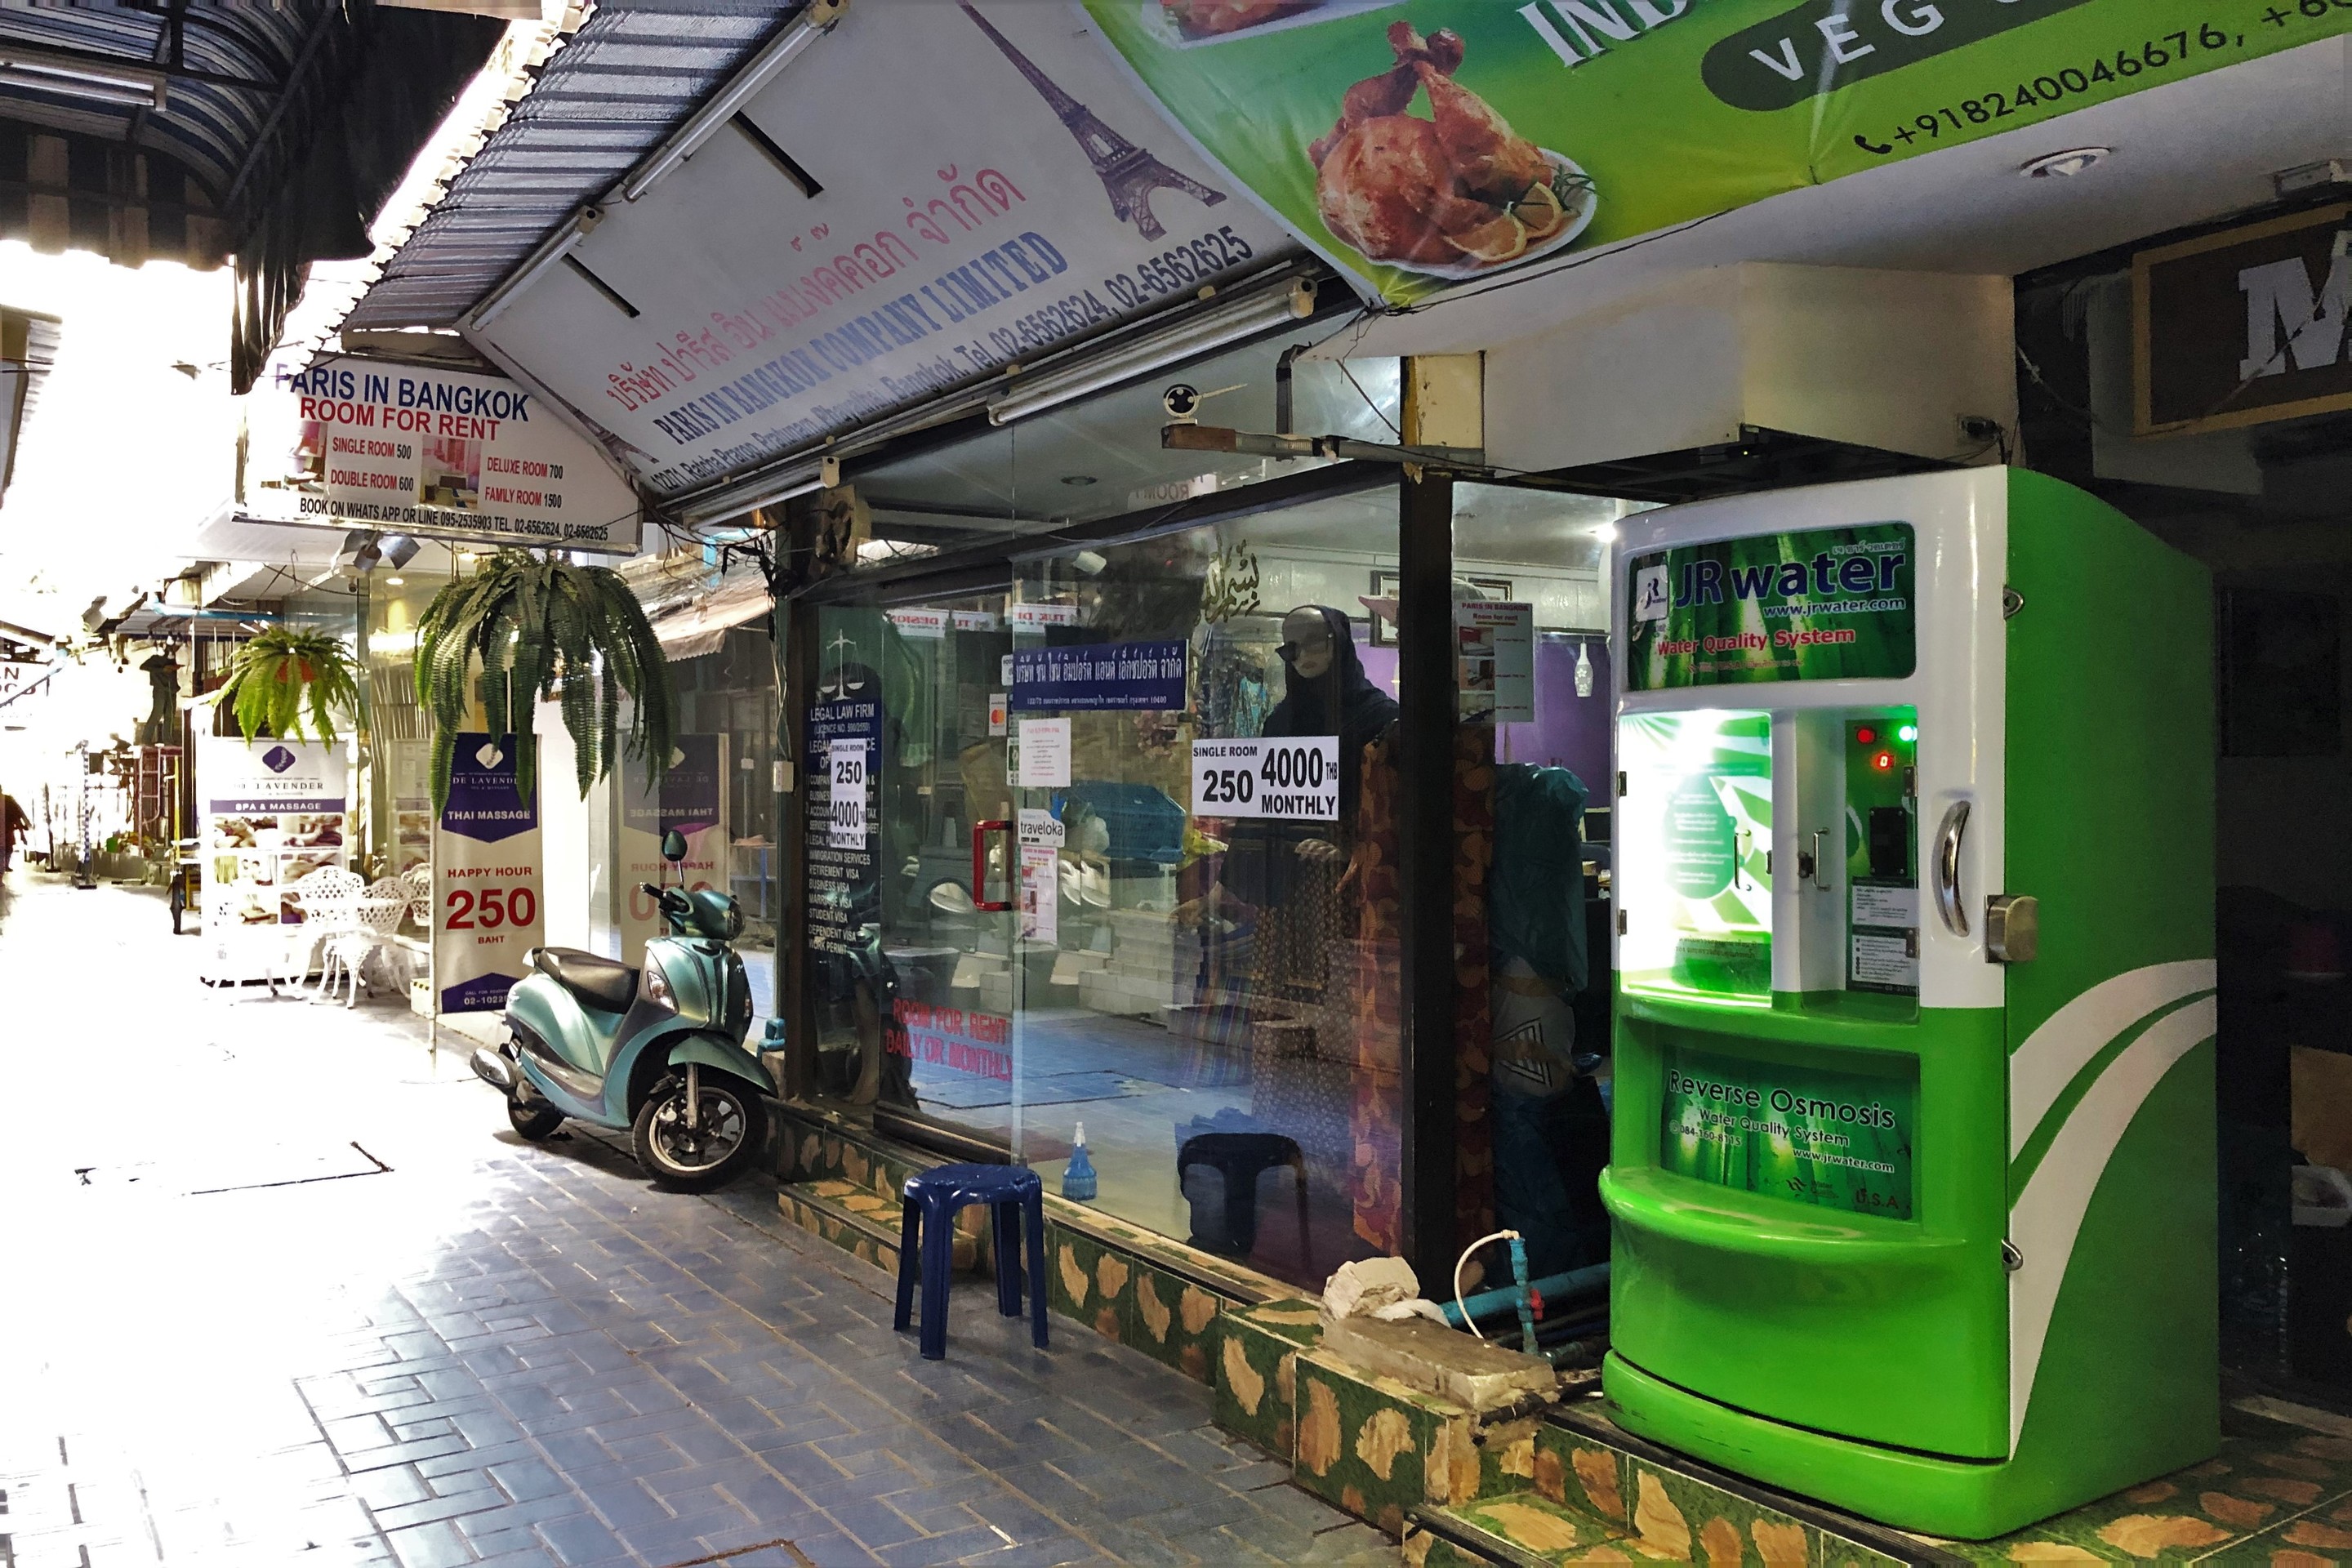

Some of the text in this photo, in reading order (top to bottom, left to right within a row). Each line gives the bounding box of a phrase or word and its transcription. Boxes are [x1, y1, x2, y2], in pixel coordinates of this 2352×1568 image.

[1104, 225, 1254, 309] 02-6562625
[606, 361, 677, 412] บริษัท
[902, 163, 1027, 244] จำกัด
[653, 230, 1069, 445] PARIS IN BANGKOK COMPANY LIMITED
[364, 373, 390, 404] IN
[399, 377, 530, 421] BANGKOK
[301, 397, 501, 442] ROOM FOR RENT
[332, 437, 412, 460] SINGLE ROOM 500
[487, 457, 564, 480] DELUXE ROOM 700
[330, 469, 414, 492] DOUBLE ROOM 600
[484, 486, 562, 510] FAMILY ROOM 1500
[300, 497, 328, 515] BOOK
[330, 500, 345, 517] ON
[346, 501, 379, 520] WHATS
[381, 504, 401, 522] APP
[403, 506, 417, 523] OR
[418, 508, 439, 526] LINE
[440, 510, 492, 530] 095-2535903
[494, 515, 513, 532] TEL.
[564, 523, 608, 541] 02-6562625
[1675, 551, 1906, 608] JR water
[1763, 598, 1906, 618] www.jrwater.com
[1657, 628, 1856, 656] Water Quality System
[810, 703, 875, 721] LEGAL LAW FIRM
[831, 744, 849, 752] SINGLE
[1193, 746, 1258, 758] SINGLE ROOM
[836, 761, 862, 785] 250
[1261, 747, 1338, 789] 4000 THB
[1202, 769, 1254, 804] 250
[235, 803, 256, 811] SPA
[260, 803, 266, 811] &
[448, 810, 531, 820] THAI MASSAGE
[831, 800, 859, 828] 4000
[1261, 794, 1336, 816] MONTHLY
[831, 831, 865, 846] MONTHLY
[1021, 821, 1062, 836] traveloka
[844, 853, 871, 865] SERVICES
[448, 866, 532, 878] HAPPY HOUR
[808, 864, 860, 880] RETIREMENT VISA
[808, 879, 850, 893] BUSINESS VISA
[445, 887, 536, 930] 250
[840, 897, 853, 909] VISA
[808, 908, 849, 923] STUDENT VISA
[478, 935, 505, 944] BAHT
[808, 924, 857, 942] DEPENDENT VISA
[826, 941, 848, 955] PERMIT
[893, 997, 1007, 1046] ROOM FOR RENT
[885, 1027, 1013, 1083] DAILY OR MONTHLY
[1669, 1069, 1895, 1129] Reverse Osmosis
[1699, 1108, 1850, 1147] Water Quality System
[1793, 1147, 1895, 1174] www.jrwater.com
